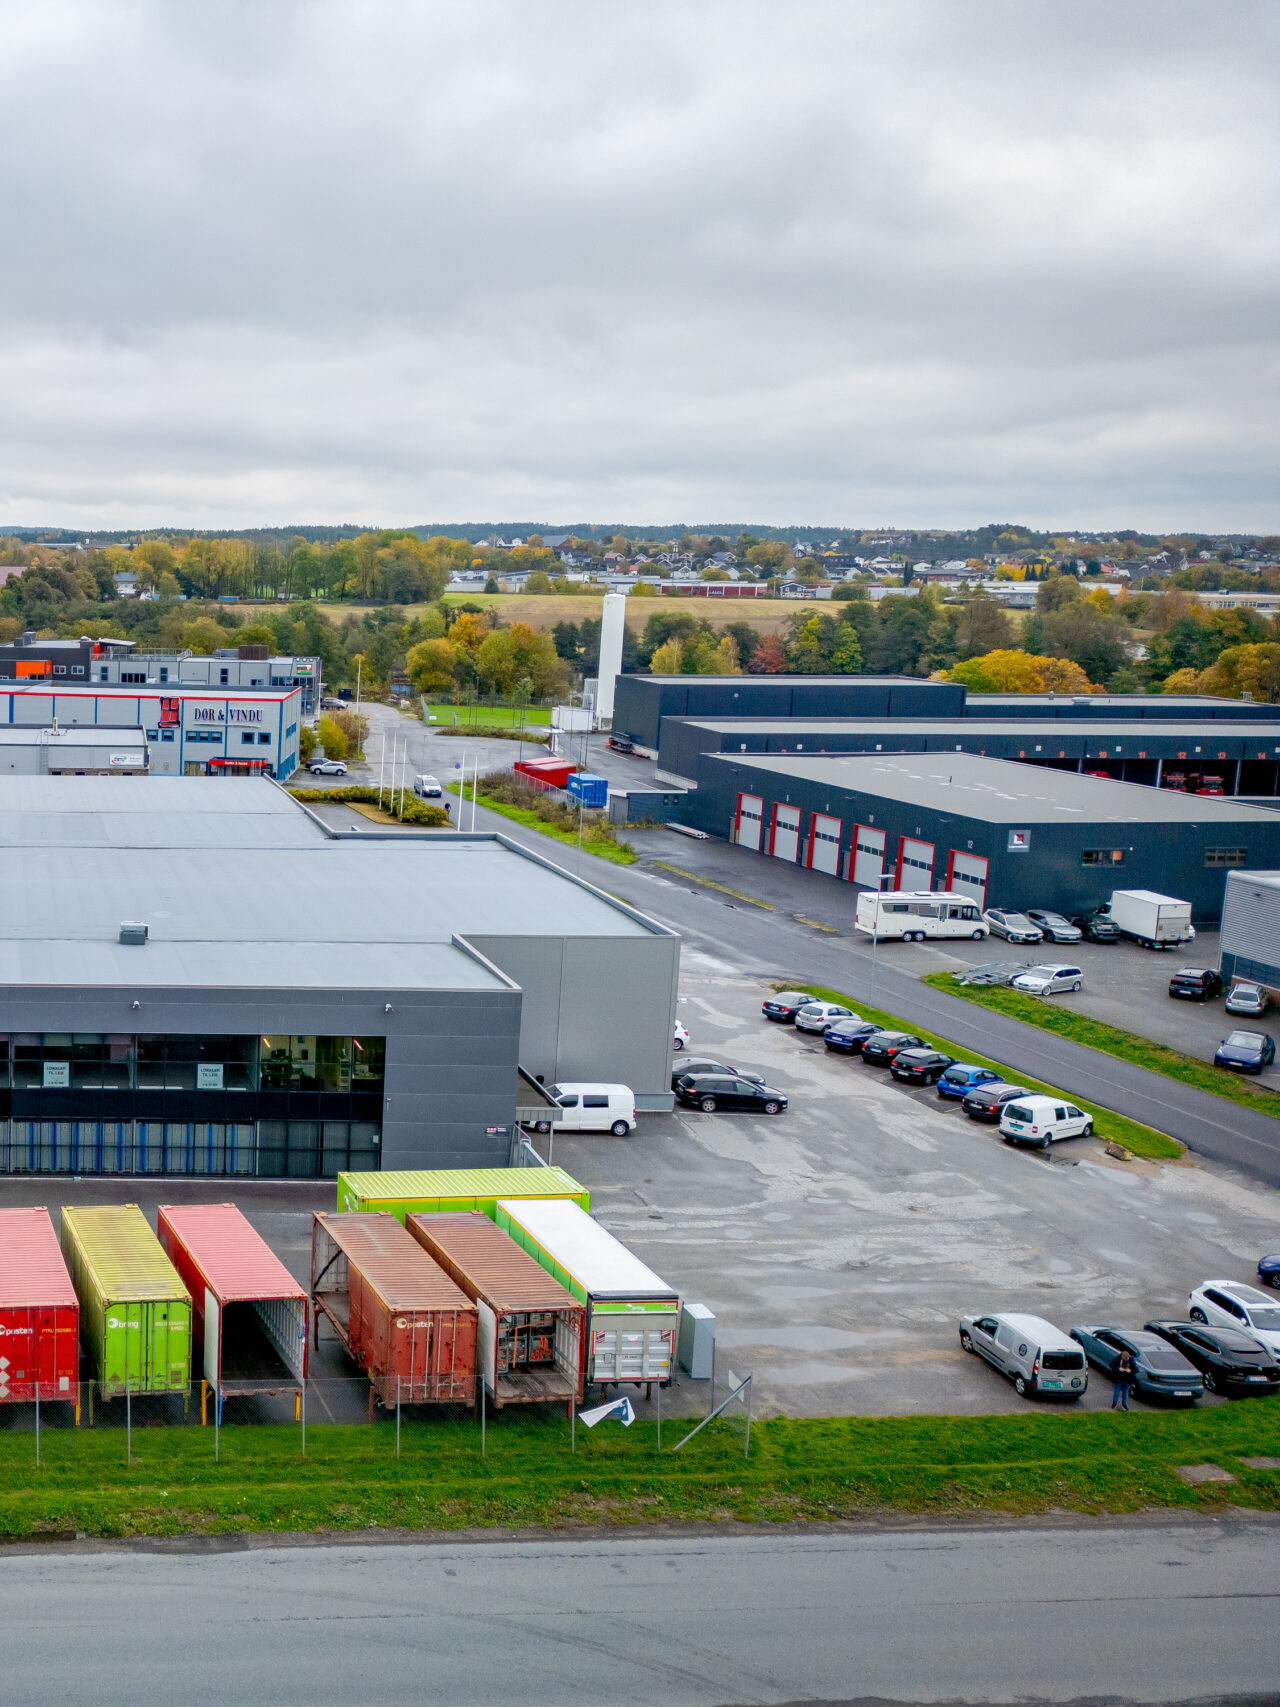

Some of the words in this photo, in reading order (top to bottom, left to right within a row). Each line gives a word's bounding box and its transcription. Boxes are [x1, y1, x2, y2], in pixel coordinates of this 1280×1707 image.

[194, 708, 215, 721] DØR
[217, 709, 225, 721] &
[229, 709, 263, 722] VINDU
[118, 1321, 139, 1329] bring
[406, 1320, 434, 1329] posten
[6, 1327, 33, 1336] posten
